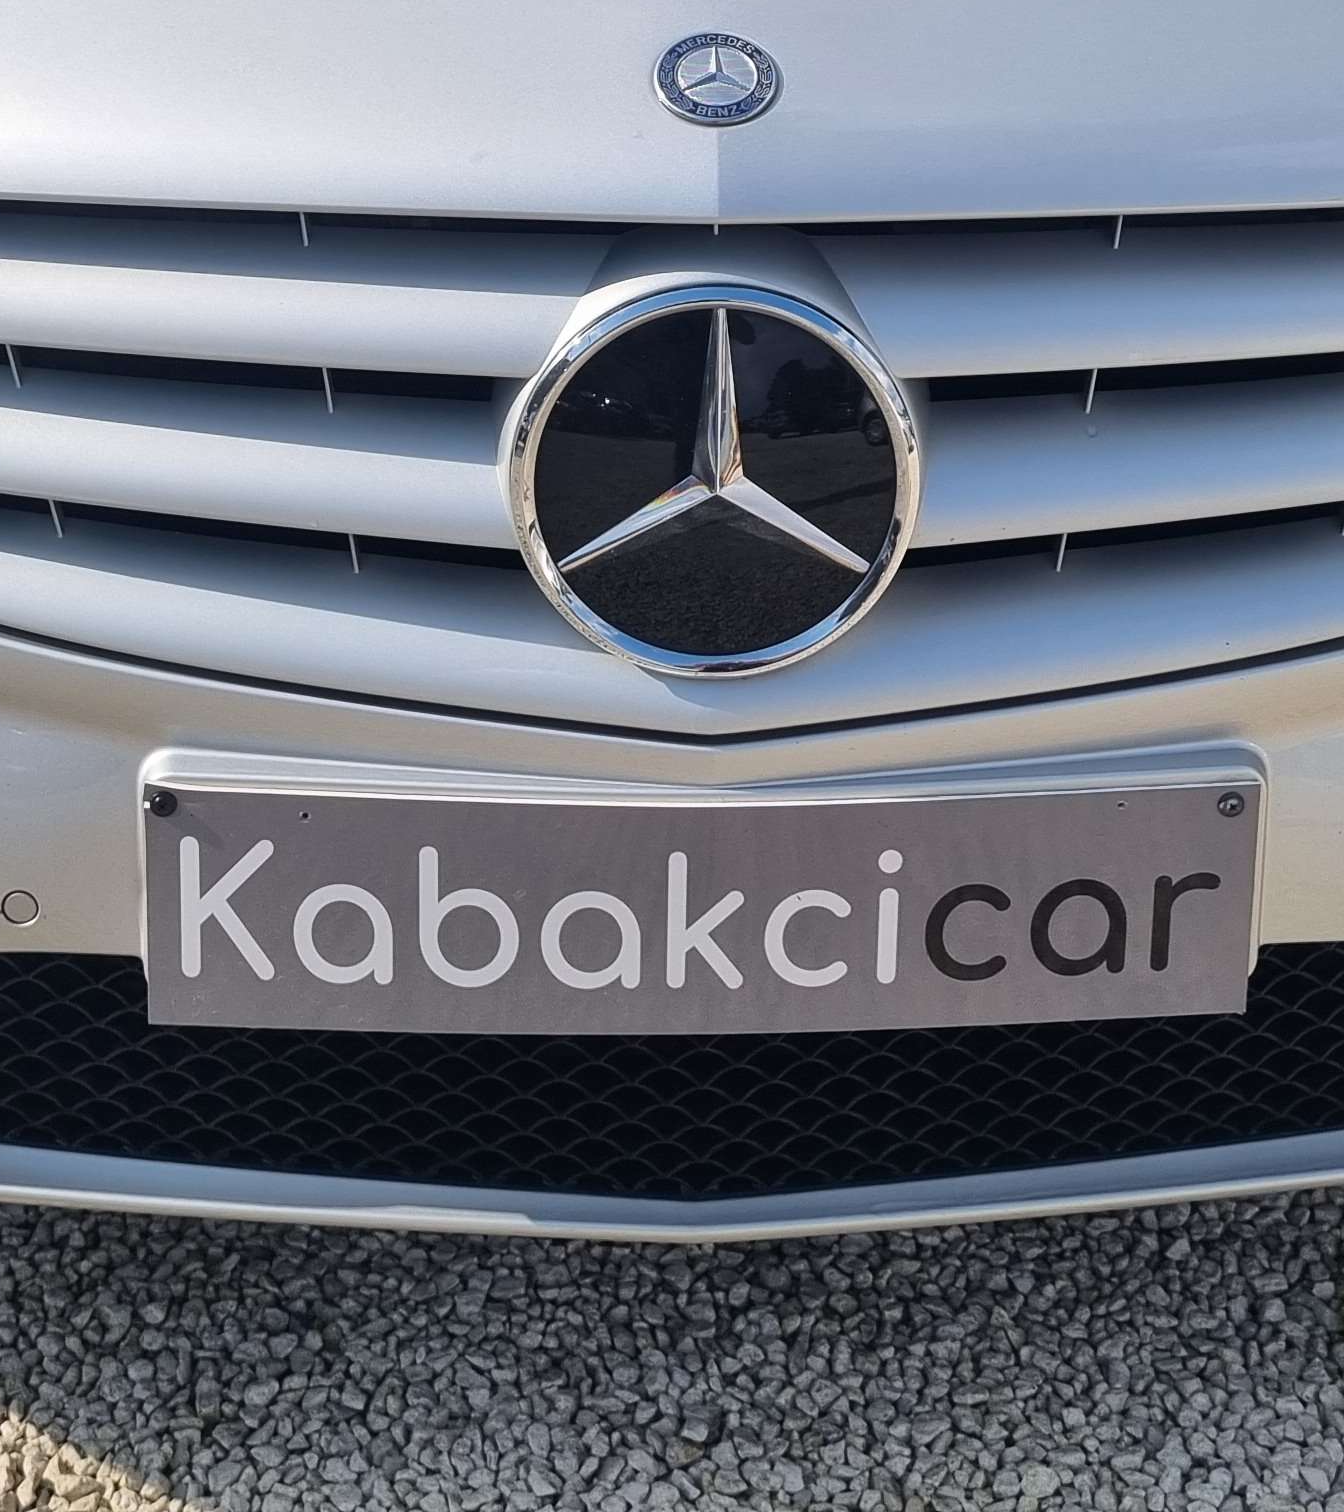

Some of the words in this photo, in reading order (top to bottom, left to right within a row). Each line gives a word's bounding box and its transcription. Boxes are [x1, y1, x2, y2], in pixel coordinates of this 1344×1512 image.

[677, 35, 754, 54] MERCEDES
[696, 105, 740, 117] BENZ
[180, 836, 1221, 988] Kabakcicar
